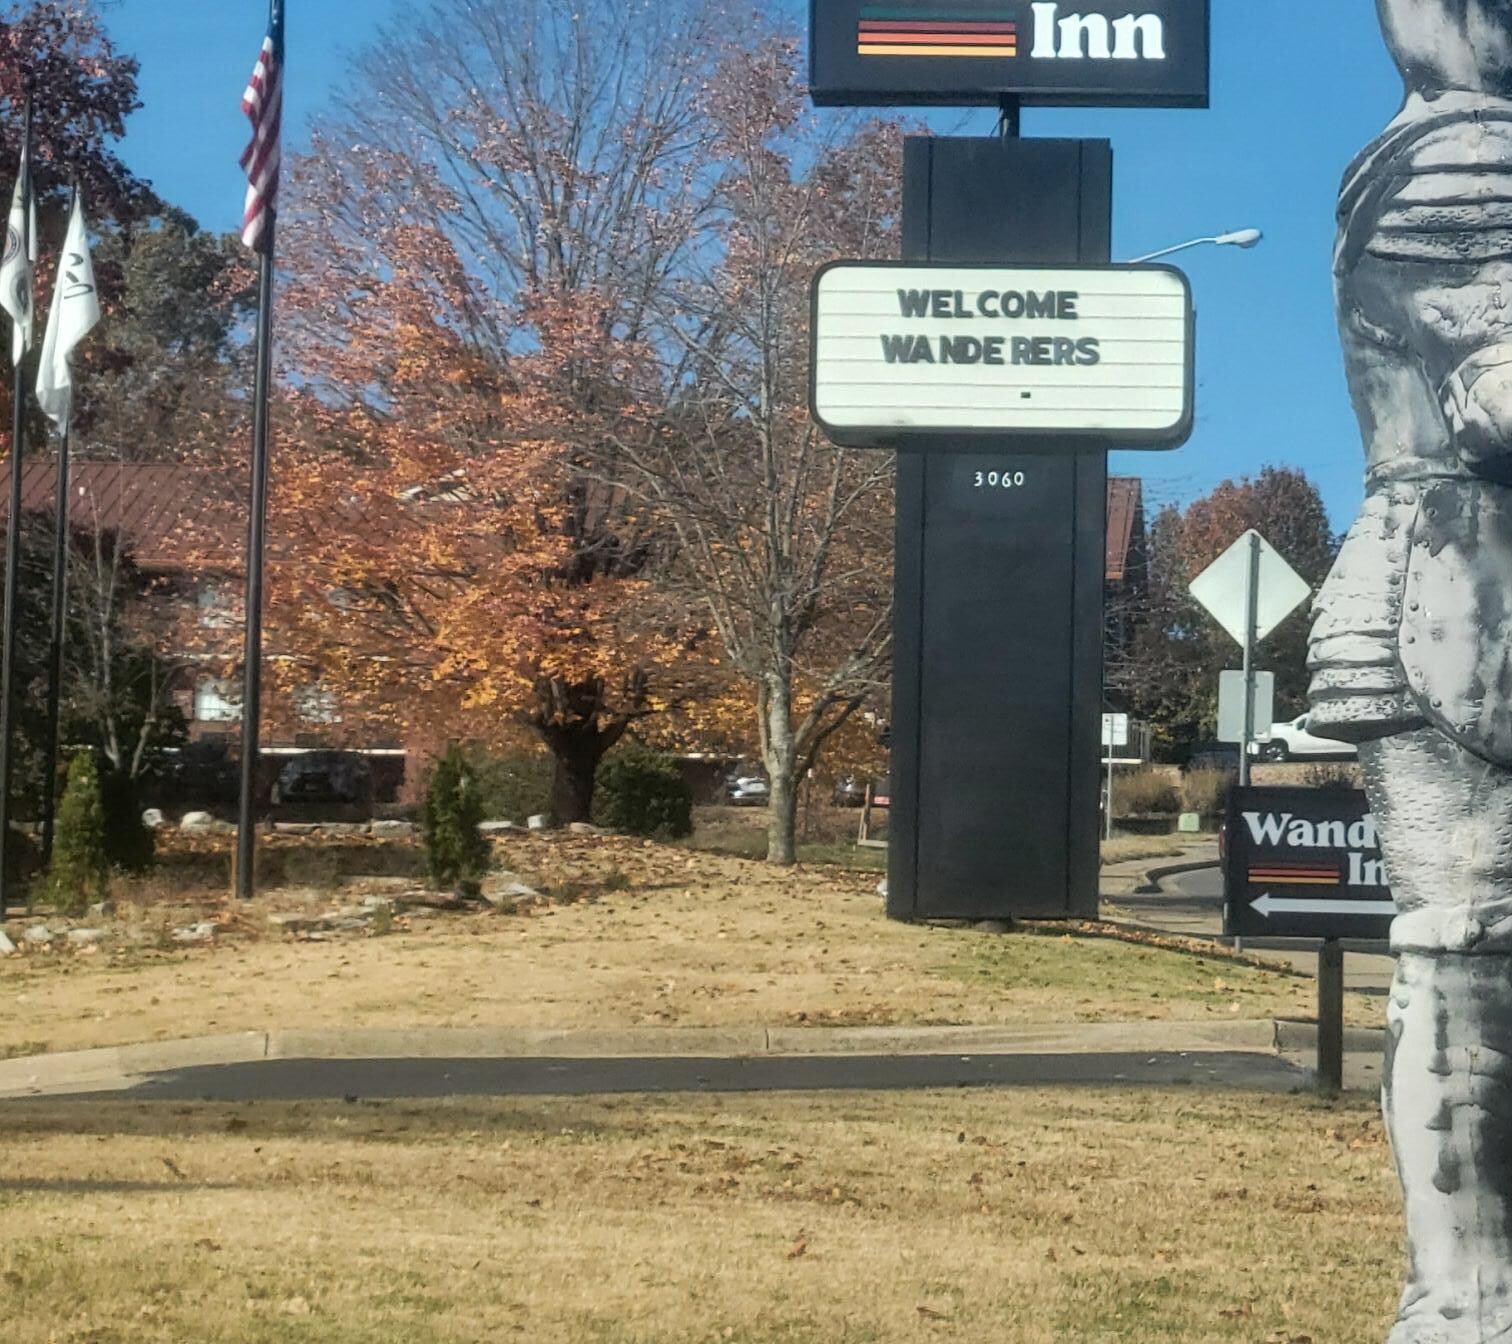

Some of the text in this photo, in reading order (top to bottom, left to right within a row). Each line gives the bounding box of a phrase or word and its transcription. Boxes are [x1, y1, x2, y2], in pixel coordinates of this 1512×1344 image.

[1030, 1, 1166, 60] Inn
[896, 288, 1079, 320] WELCOME
[880, 334, 1101, 366] WANDERERS
[974, 471, 1025, 488] 3060
[1241, 811, 1378, 849] Wand
[1347, 852, 1390, 886] In
